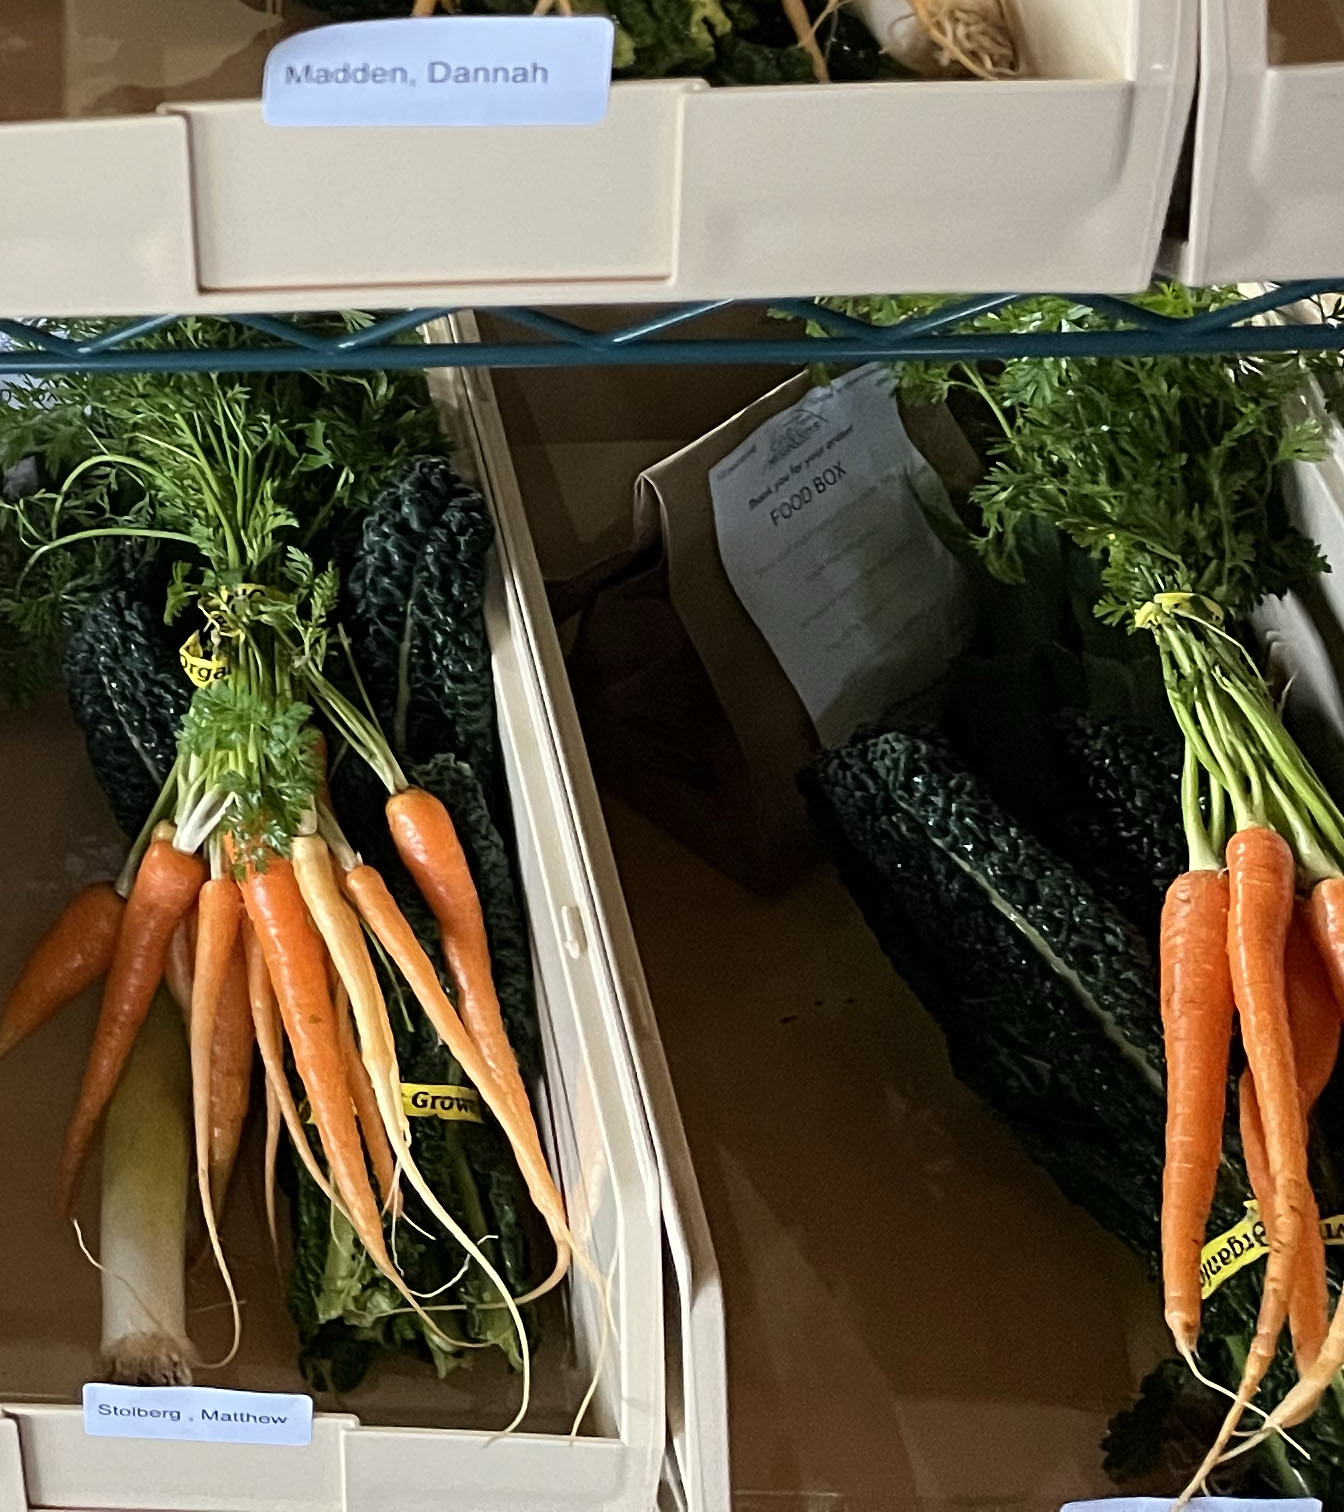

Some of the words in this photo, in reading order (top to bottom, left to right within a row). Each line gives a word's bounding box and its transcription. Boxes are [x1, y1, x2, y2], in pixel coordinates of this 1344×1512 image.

[285, 62, 418, 87] Madden,
[427, 61, 549, 84] Dannah
[770, 486, 812, 526] FOOD
[813, 460, 847, 494] BOX
[98, 1403, 182, 1421] Stolberg
[201, 1409, 288, 1425] Matthew
